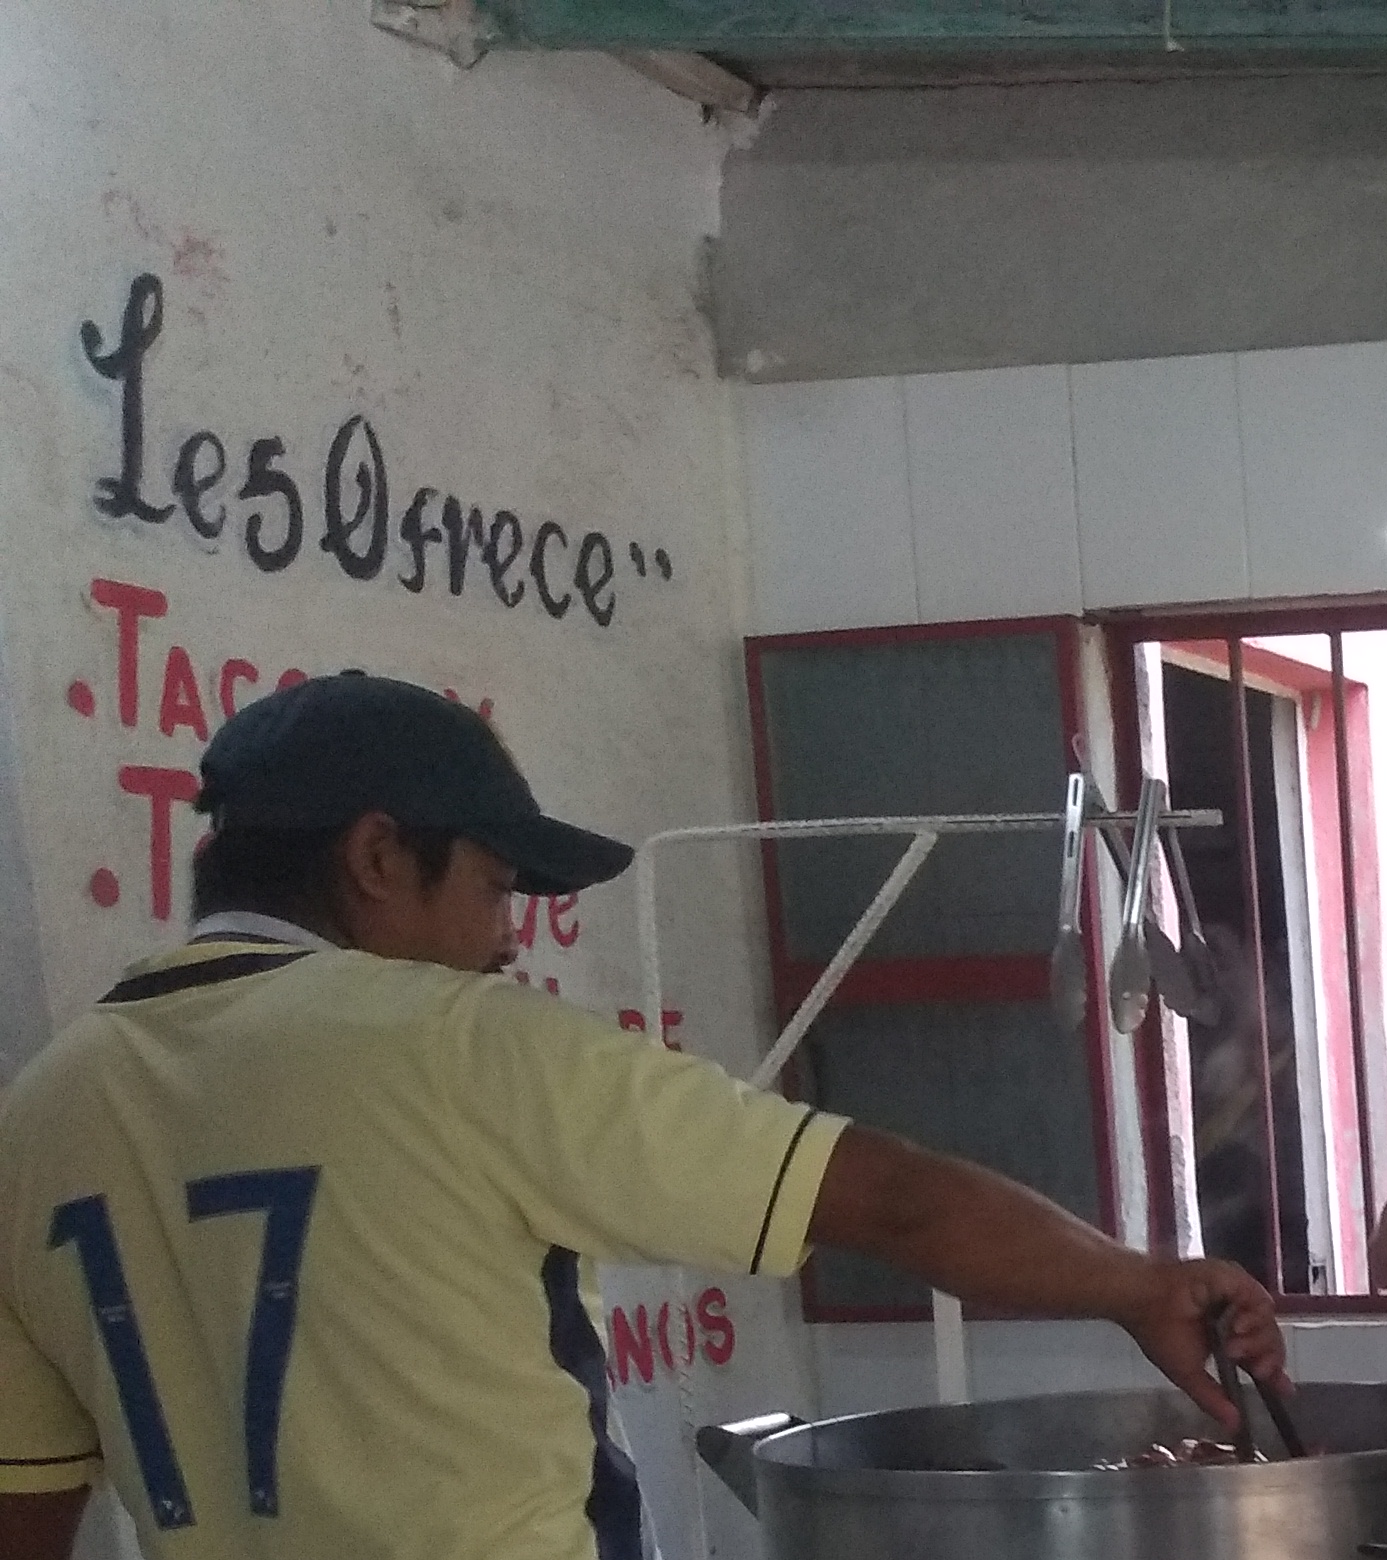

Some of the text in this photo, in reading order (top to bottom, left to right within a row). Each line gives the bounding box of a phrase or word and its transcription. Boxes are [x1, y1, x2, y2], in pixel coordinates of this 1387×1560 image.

[81, 271, 305, 572] Les
[90, 577, 309, 742] TAC
[46, 1165, 322, 1530] 17
